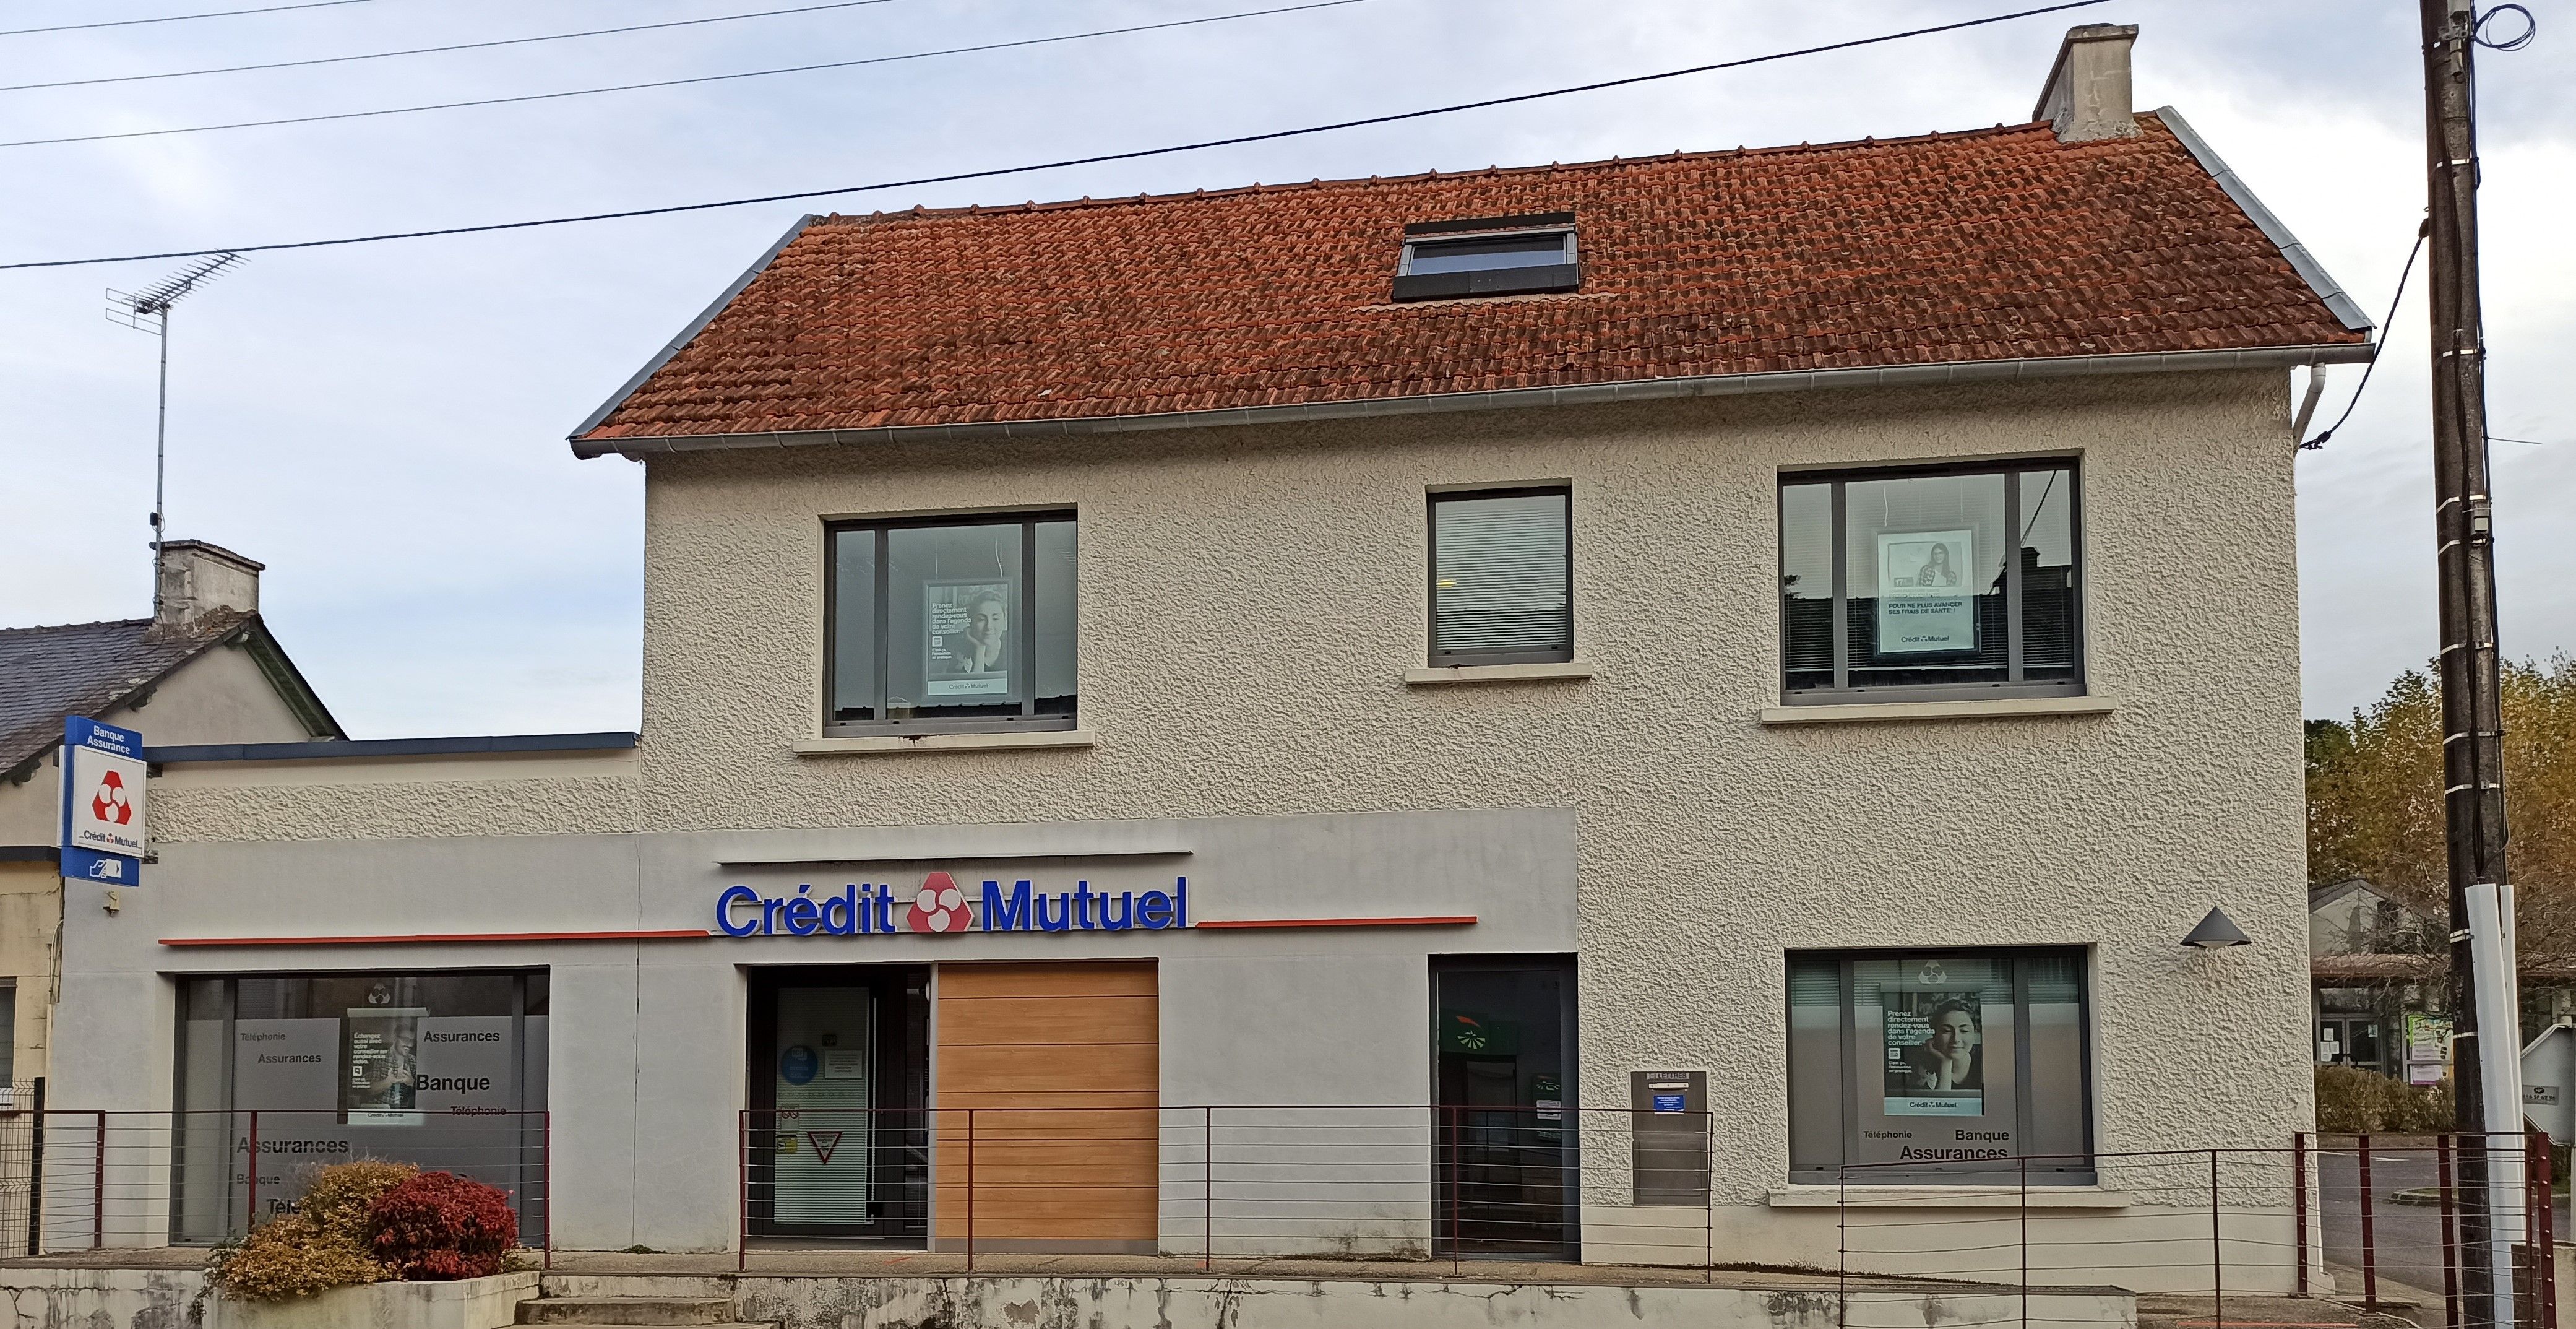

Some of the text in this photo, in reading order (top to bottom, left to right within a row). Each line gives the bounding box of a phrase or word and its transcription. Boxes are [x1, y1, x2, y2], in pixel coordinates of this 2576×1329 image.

[93, 725, 124, 742] Banque
[87, 735, 131, 755] Assurance
[84, 830, 138, 848] Crédit Mutuel
[715, 877, 1189, 937] Crédit Mutuel
[241, 1032, 286, 1042] Téléphonie
[423, 1031, 501, 1042] Assurances
[258, 1054, 321, 1063] Assurances
[416, 1074, 491, 1094] Banque
[450, 1106, 507, 1117] Téléphonie
[1863, 1130, 1913, 1140] Téléphonie
[1955, 1129, 2010, 1143] Banque
[1900, 1145, 2008, 1160] Assurances
